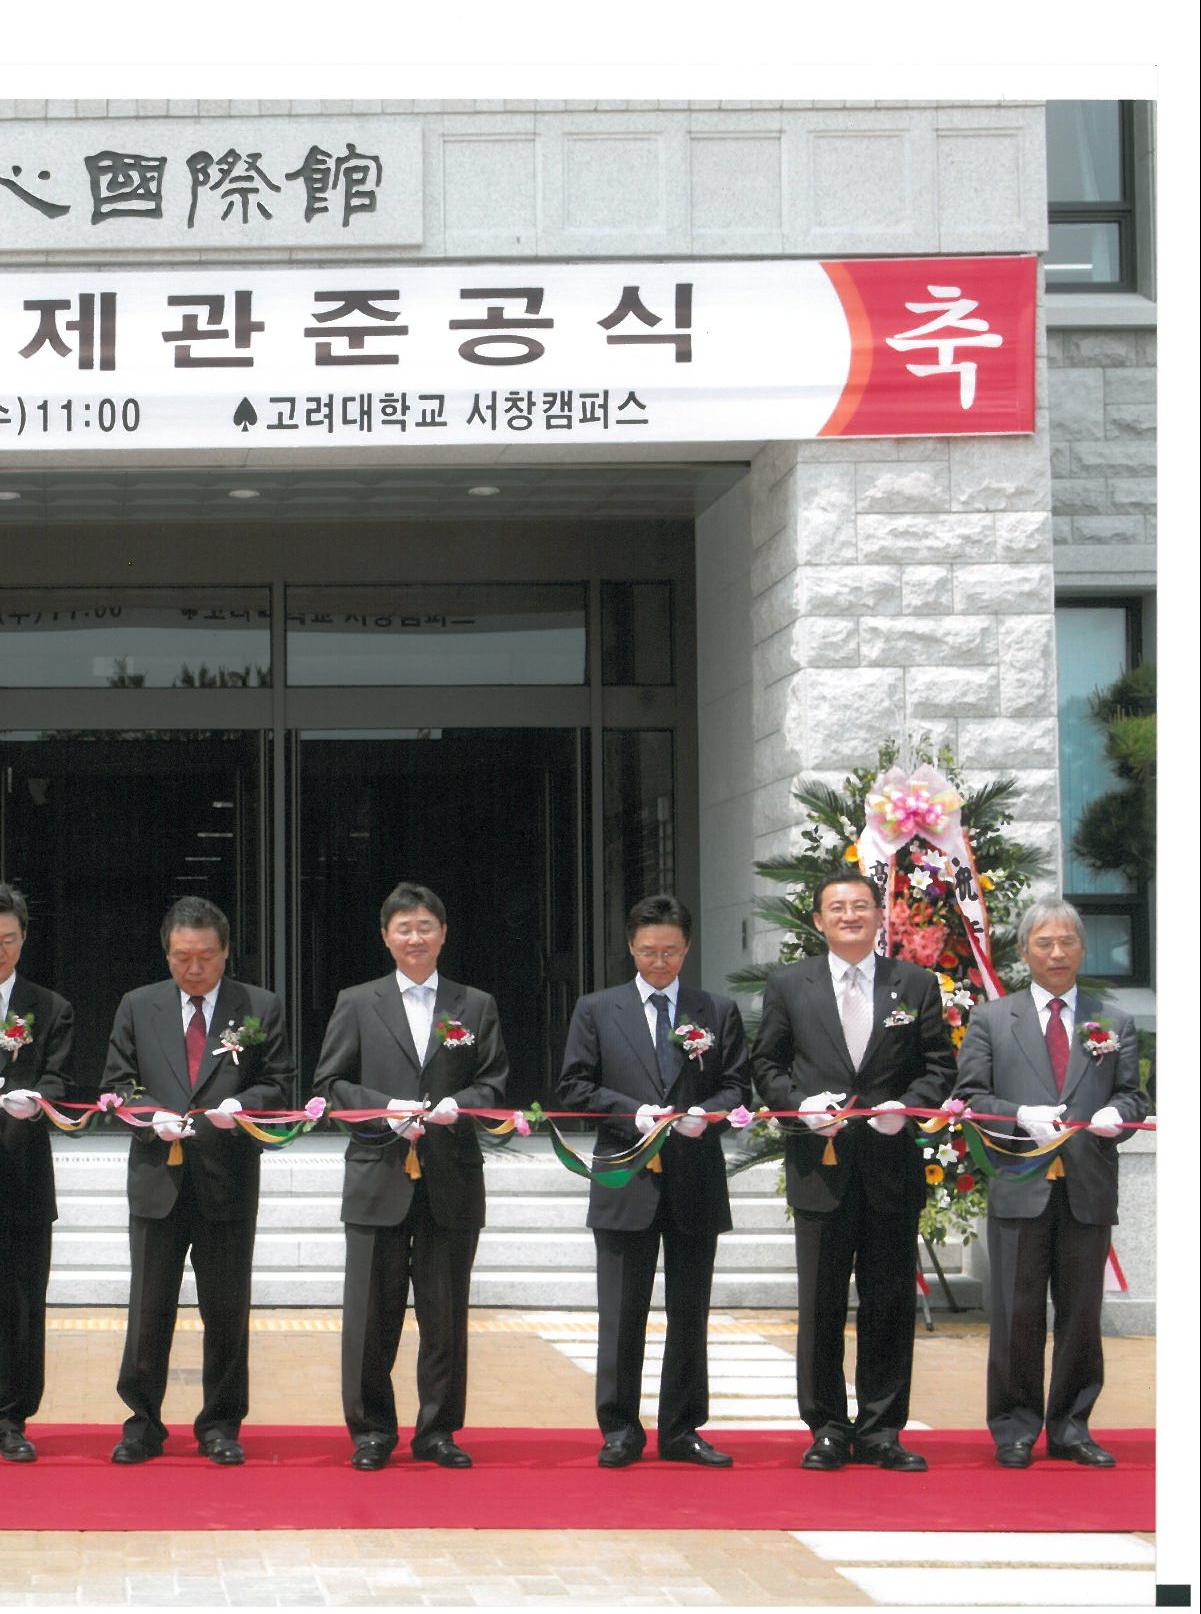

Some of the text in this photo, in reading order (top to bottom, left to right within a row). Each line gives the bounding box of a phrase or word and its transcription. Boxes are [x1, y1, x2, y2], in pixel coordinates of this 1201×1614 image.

[886, 286, 1003, 410] 축
[267, 389, 649, 434] 고려대학교 서창캠퍼스
